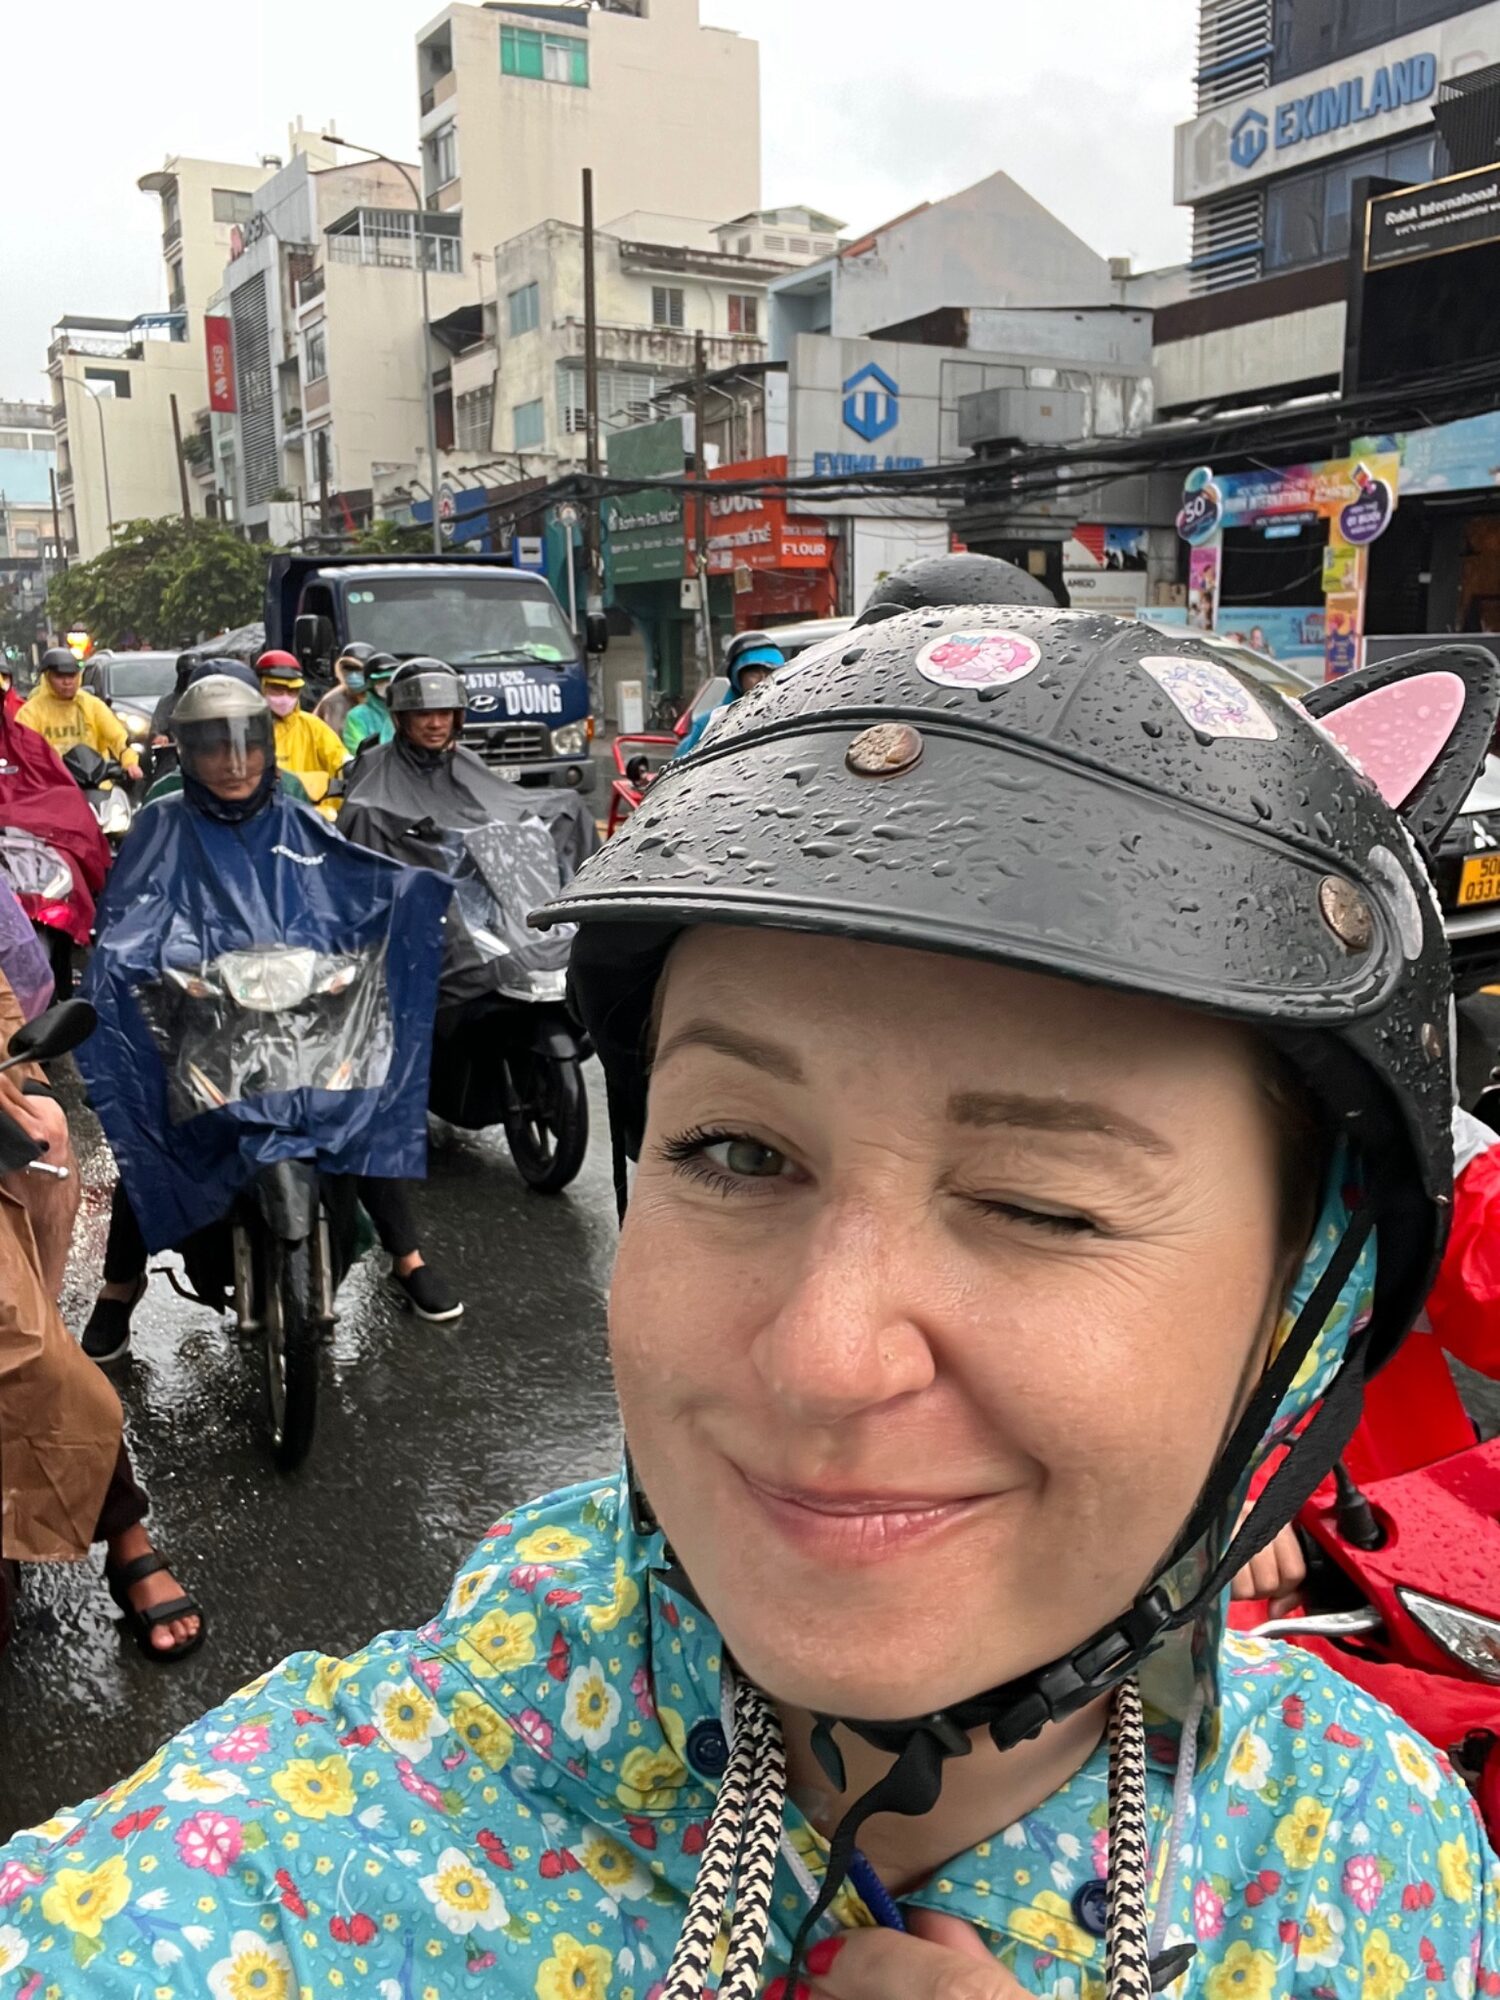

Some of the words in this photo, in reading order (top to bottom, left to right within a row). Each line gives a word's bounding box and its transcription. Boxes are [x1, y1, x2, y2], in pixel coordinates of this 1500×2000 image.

[1275, 52, 1437, 150] EXIMLAND
[1419, 183, 1498, 217] International
[781, 542, 827, 556] FLOUR
[504, 683, 562, 716] DUNG
